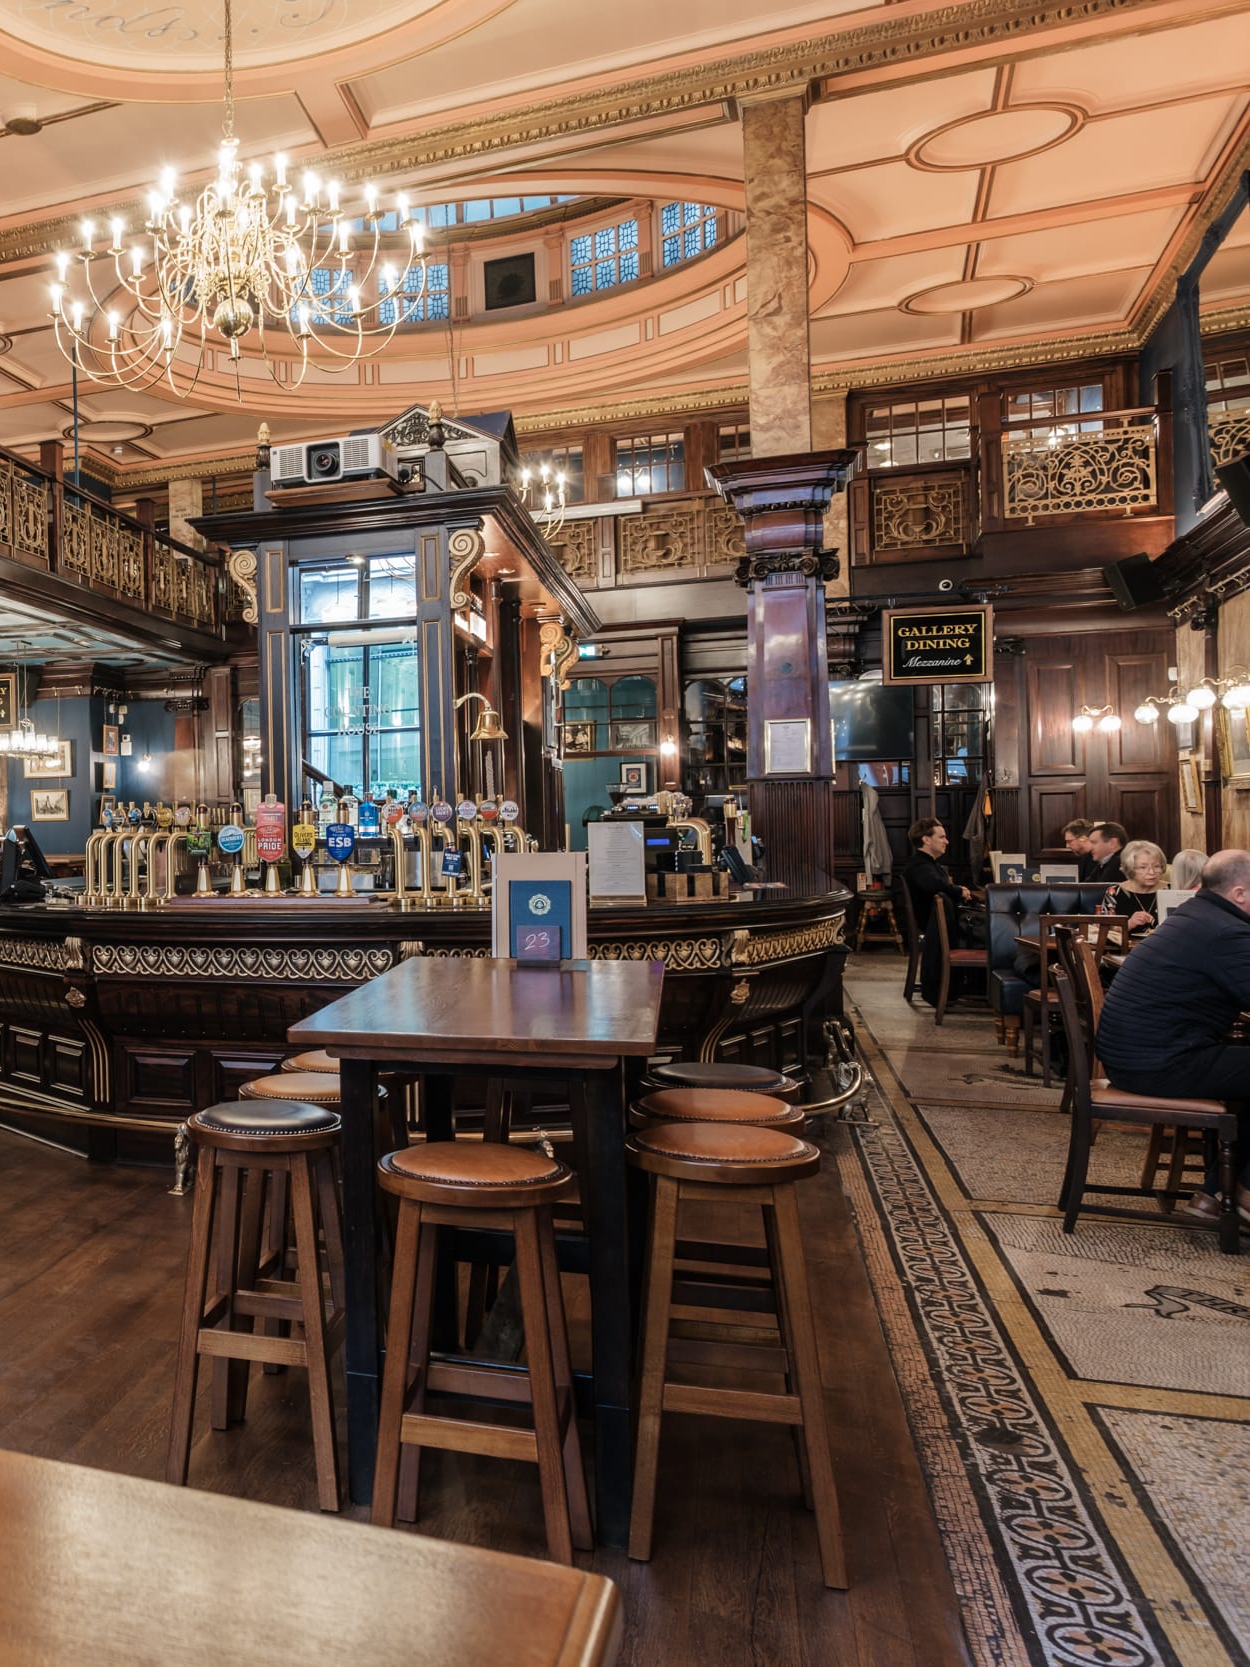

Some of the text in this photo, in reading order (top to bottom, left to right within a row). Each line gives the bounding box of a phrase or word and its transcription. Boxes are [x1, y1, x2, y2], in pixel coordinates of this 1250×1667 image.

[898, 624, 978, 637] GALLERY
[906, 638, 970, 650] DINING
[902, 655, 962, 668] Mezzanine
[345, 687, 370, 699] THE
[338, 722, 380, 736] HOUSE
[257, 842, 282, 850] PRIDE
[328, 837, 352, 848] ESB
[524, 932, 550, 951] 23
